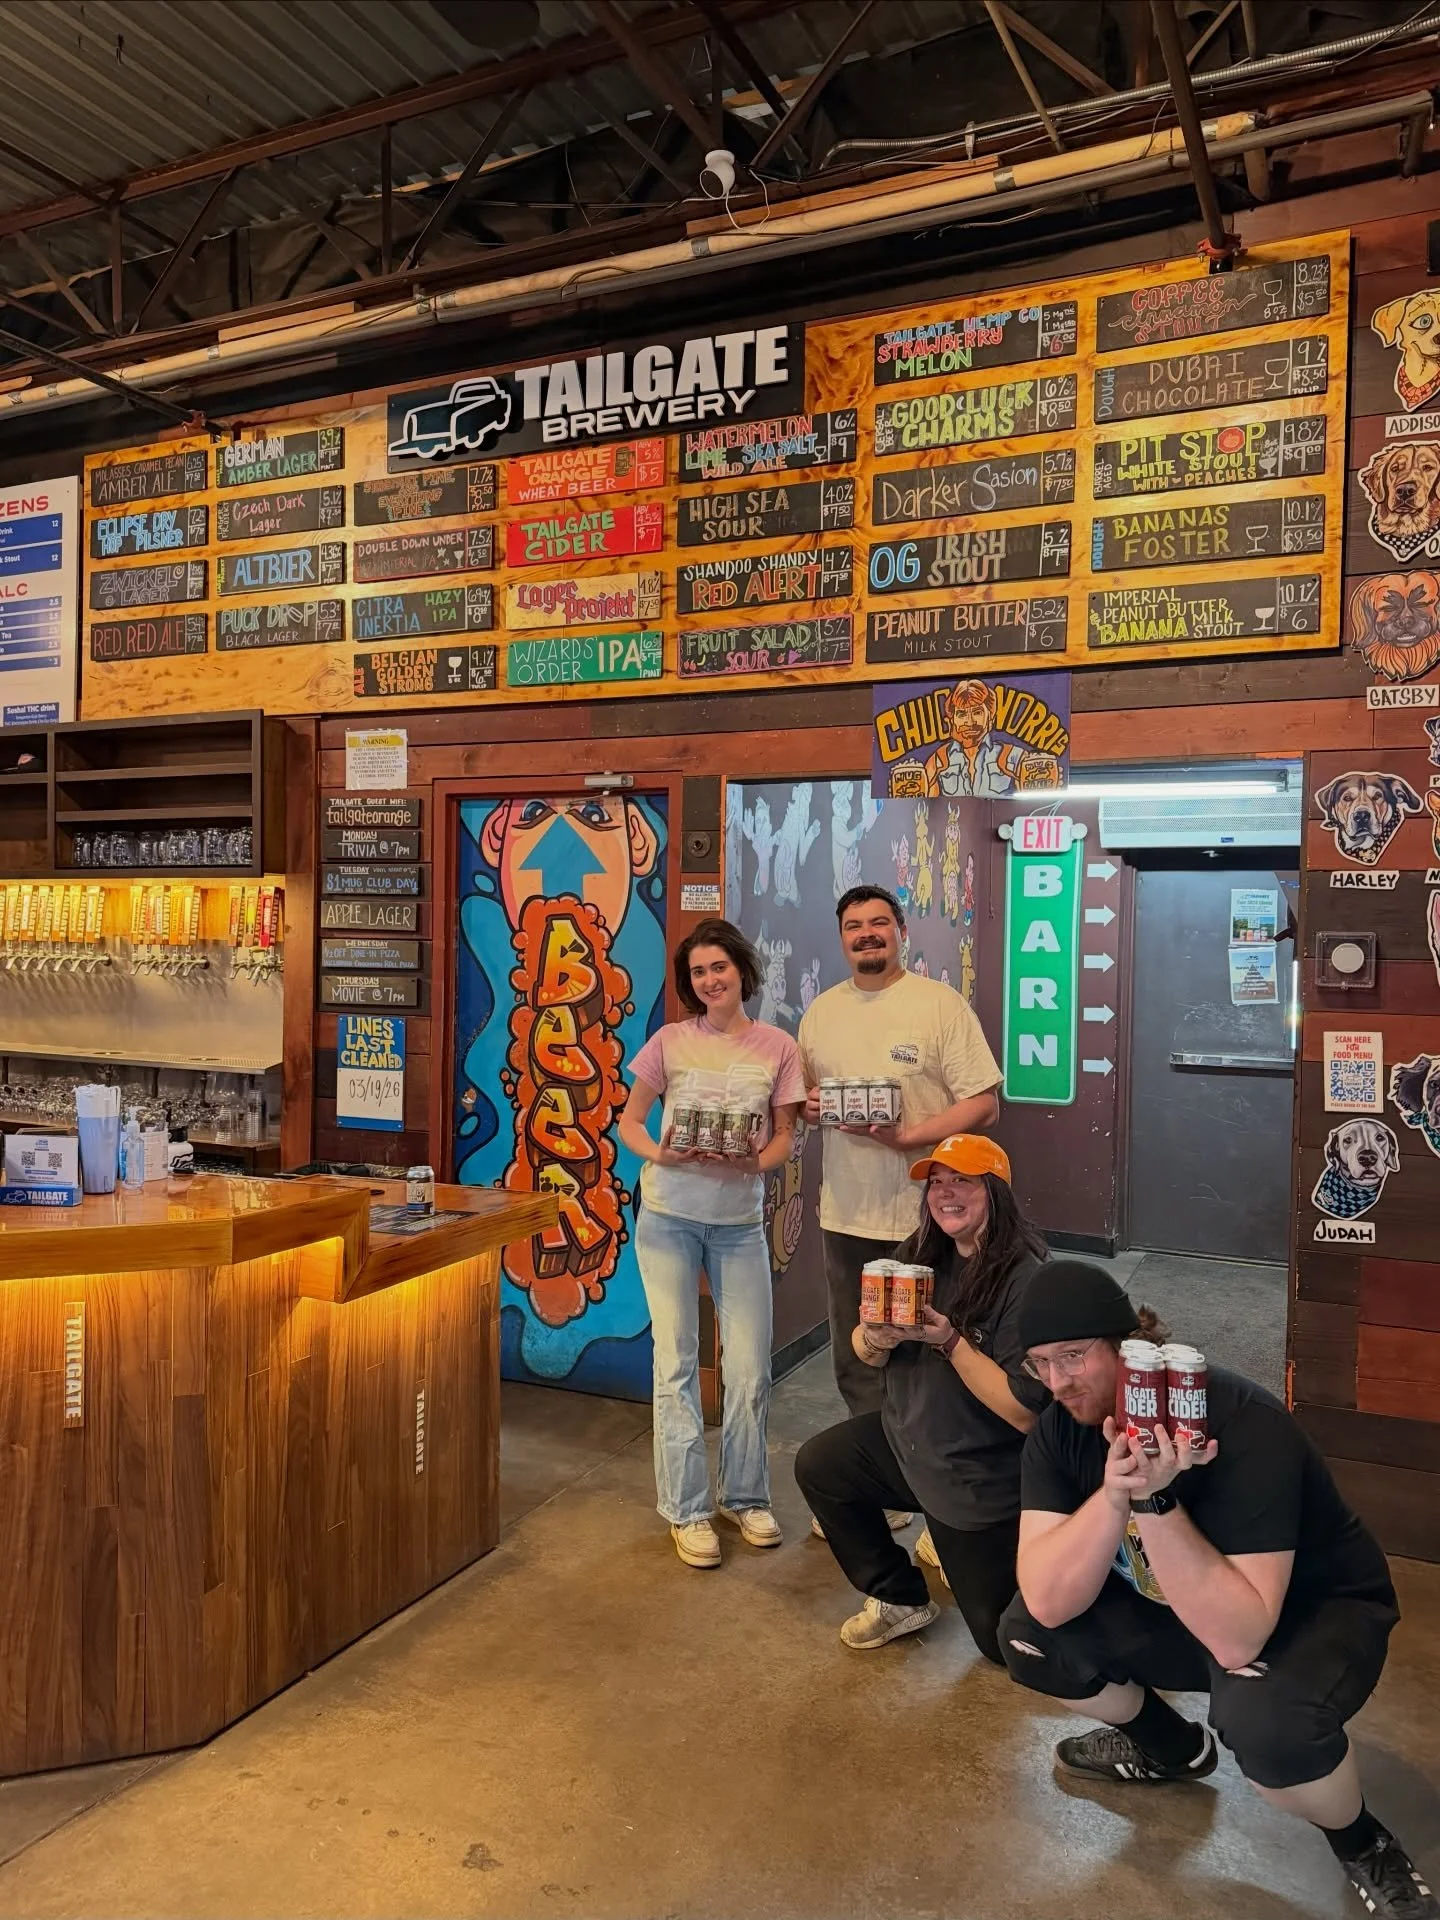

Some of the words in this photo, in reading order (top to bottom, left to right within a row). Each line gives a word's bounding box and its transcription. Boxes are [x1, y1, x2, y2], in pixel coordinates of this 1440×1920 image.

[1131, 277, 1225, 311] COFFEE
[884, 321, 955, 344] TAILGATE
[963, 311, 1012, 332] HEMP
[878, 326, 1003, 363] STRAWBERRY
[515, 325, 790, 420] TAILGATE
[895, 347, 972, 379] MELON
[1150, 352, 1244, 386] DUBAI
[1122, 377, 1265, 414] CHOCOLATE
[1292, 385, 1319, 395] TULIP
[541, 389, 757, 443] BREWERY
[891, 394, 956, 429] GOOD
[967, 380, 1034, 415] LUCK
[686, 415, 813, 453] WATERMELON
[834, 412, 855, 430] 6%
[902, 406, 1015, 448] CHARMS
[225, 436, 284, 468] GERMAN
[520, 448, 612, 476] TAILGATE
[686, 448, 727, 470] LIME
[742, 442, 775, 464] SEA
[778, 433, 818, 456] SALT
[1120, 435, 1167, 466] PIT
[228, 462, 272, 485] AMBER
[277, 451, 318, 476] LAGER
[528, 465, 609, 485] ORANGE
[701, 462, 744, 479] WILD
[751, 456, 788, 473] ALE
[1117, 460, 1176, 481] WHITE
[1189, 452, 1261, 472] STOUT
[1133, 478, 1169, 492] WITH
[1184, 467, 1257, 487] PEACHES
[98, 475, 146, 501] AMBER
[152, 470, 177, 493] ALE
[519, 484, 562, 501] WHEAT
[568, 478, 616, 495] BEER
[882, 469, 968, 521] Darker
[232, 499, 270, 520] Czech
[689, 494, 739, 523] HIGH
[745, 488, 790, 514] SEA
[153, 510, 177, 532] DRY
[250, 518, 282, 533] Lager
[521, 510, 616, 541] TAILGATE
[702, 516, 765, 542] SOUR
[1112, 505, 1230, 540] BANANAS
[136, 528, 184, 551] PILSNER
[358, 542, 398, 557] DOUBLE
[402, 537, 429, 550] DOWN
[433, 532, 463, 546] UNDER
[525, 532, 610, 562] CIDER
[1124, 527, 1229, 563] FOSTER
[233, 549, 315, 587] ALTBIER
[684, 558, 751, 582] SHANDOO
[757, 549, 818, 571] SHANDY
[870, 542, 921, 589] OG
[935, 529, 1007, 563] IRISH
[927, 552, 1006, 587] STOUT
[100, 566, 178, 594] ZWICKEL
[692, 579, 738, 610] RED
[744, 564, 822, 603] ALERT
[1279, 580, 1320, 605] 10.1%
[121, 587, 169, 606] LAGER
[357, 597, 404, 617] CITRA
[425, 588, 462, 606] HAZY
[1031, 599, 1066, 620] 5.2%
[1103, 587, 1181, 608] IMPERIAL
[221, 606, 262, 635] PUCK
[359, 612, 420, 637] INERTIA
[432, 608, 456, 622] IPA
[874, 608, 946, 641] PEANUT
[954, 600, 1029, 632] BUTTER
[1103, 605, 1164, 625] PEANUT
[1167, 598, 1228, 618] BUTTER
[1192, 610, 1234, 627] MILK
[127, 623, 156, 653] RED
[159, 621, 184, 652] ALE
[226, 634, 260, 648] BLACK
[268, 631, 300, 642] LAGER
[686, 631, 739, 656] FRUIT
[750, 624, 812, 650] SALAD
[823, 619, 845, 635] 5%
[1100, 616, 1189, 645] BANANA
[1193, 622, 1244, 639] STOUT
[598, 639, 642, 673] IPA
[904, 639, 936, 654] MILK
[944, 634, 993, 652] STOUT
[371, 649, 438, 670] BELGIAN
[376, 664, 434, 681] GOLDEN
[518, 661, 583, 684] ORDER
[354, 667, 365, 695] ALE
[379, 677, 433, 694] STRONG
[1369, 687, 1436, 707] GATSBY
[994, 683, 1070, 757] NORRIS
[330, 798, 362, 806] TAILGATE
[326, 807, 411, 826] tailgateorange
[342, 830, 378, 840] MONDAY
[1023, 818, 1063, 849] EXIT
[338, 842, 377, 857] TRIVIA
[380, 841, 388, 854] @
[391, 842, 410, 858] 7PM
[341, 878, 362, 888] MUG
[367, 878, 391, 888] CLUB
[396, 879, 415, 888] DAY
[1333, 873, 1396, 887] HARLEY
[326, 904, 362, 925] APPLE
[368, 904, 411, 927] LAGER
[381, 950, 400, 958] PIZZA
[1019, 864, 1063, 1067] BARN
[332, 987, 365, 1001] MOVIE
[372, 989, 382, 1000] @
[337, 977, 379, 985] THURSDAY
[347, 1016, 394, 1040] LINES
[346, 1034, 395, 1053] LAST
[340, 1051, 403, 1069] CLEANED
[349, 1075, 400, 1107] 03/19/26
[941, 1137, 963, 1151] T
[27, 1191, 68, 1200] TAILGATE
[1316, 1221, 1373, 1241] JUDAH
[66, 1315, 82, 1419] TAILGATE
[1168, 1386, 1207, 1401] TAILGATE
[1168, 1400, 1207, 1419] CIDER
[416, 1389, 424, 1474] TAILGATE
